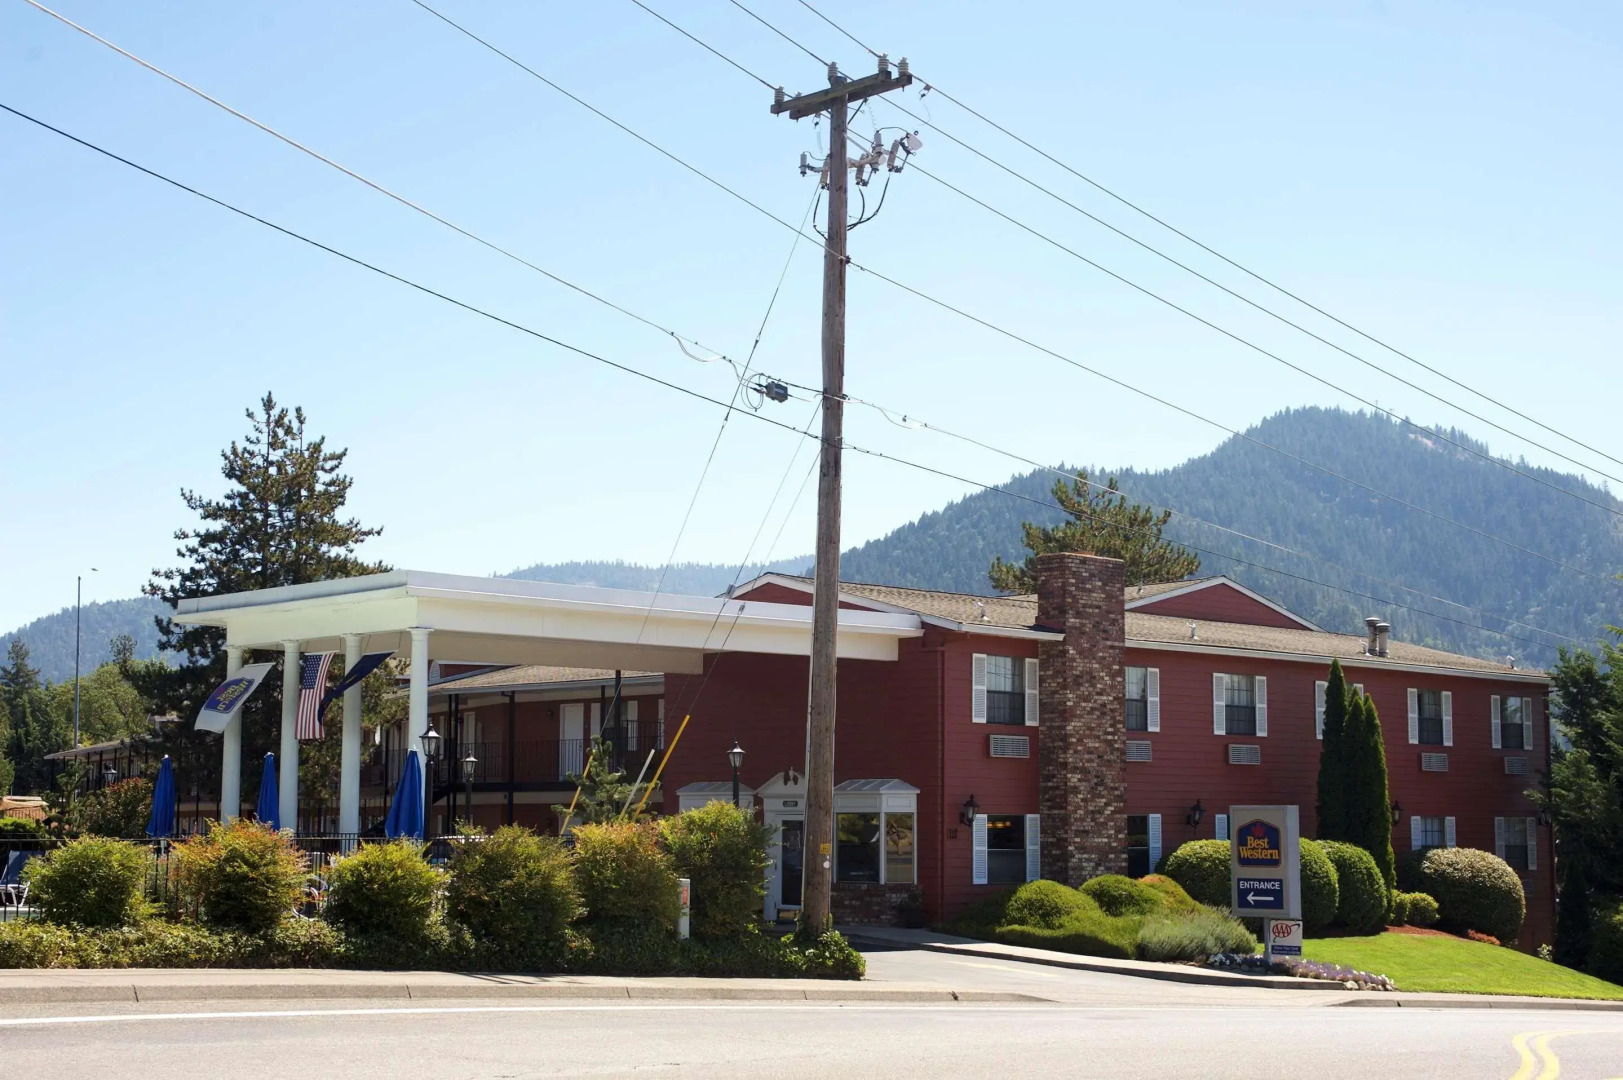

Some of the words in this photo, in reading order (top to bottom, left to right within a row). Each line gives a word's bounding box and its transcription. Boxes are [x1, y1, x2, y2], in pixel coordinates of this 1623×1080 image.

[1246, 836, 1269, 849] Best
[1239, 847, 1279, 859] Western
[1239, 880, 1281, 890] ENTRANCE
[1273, 924, 1290, 937] AAA
